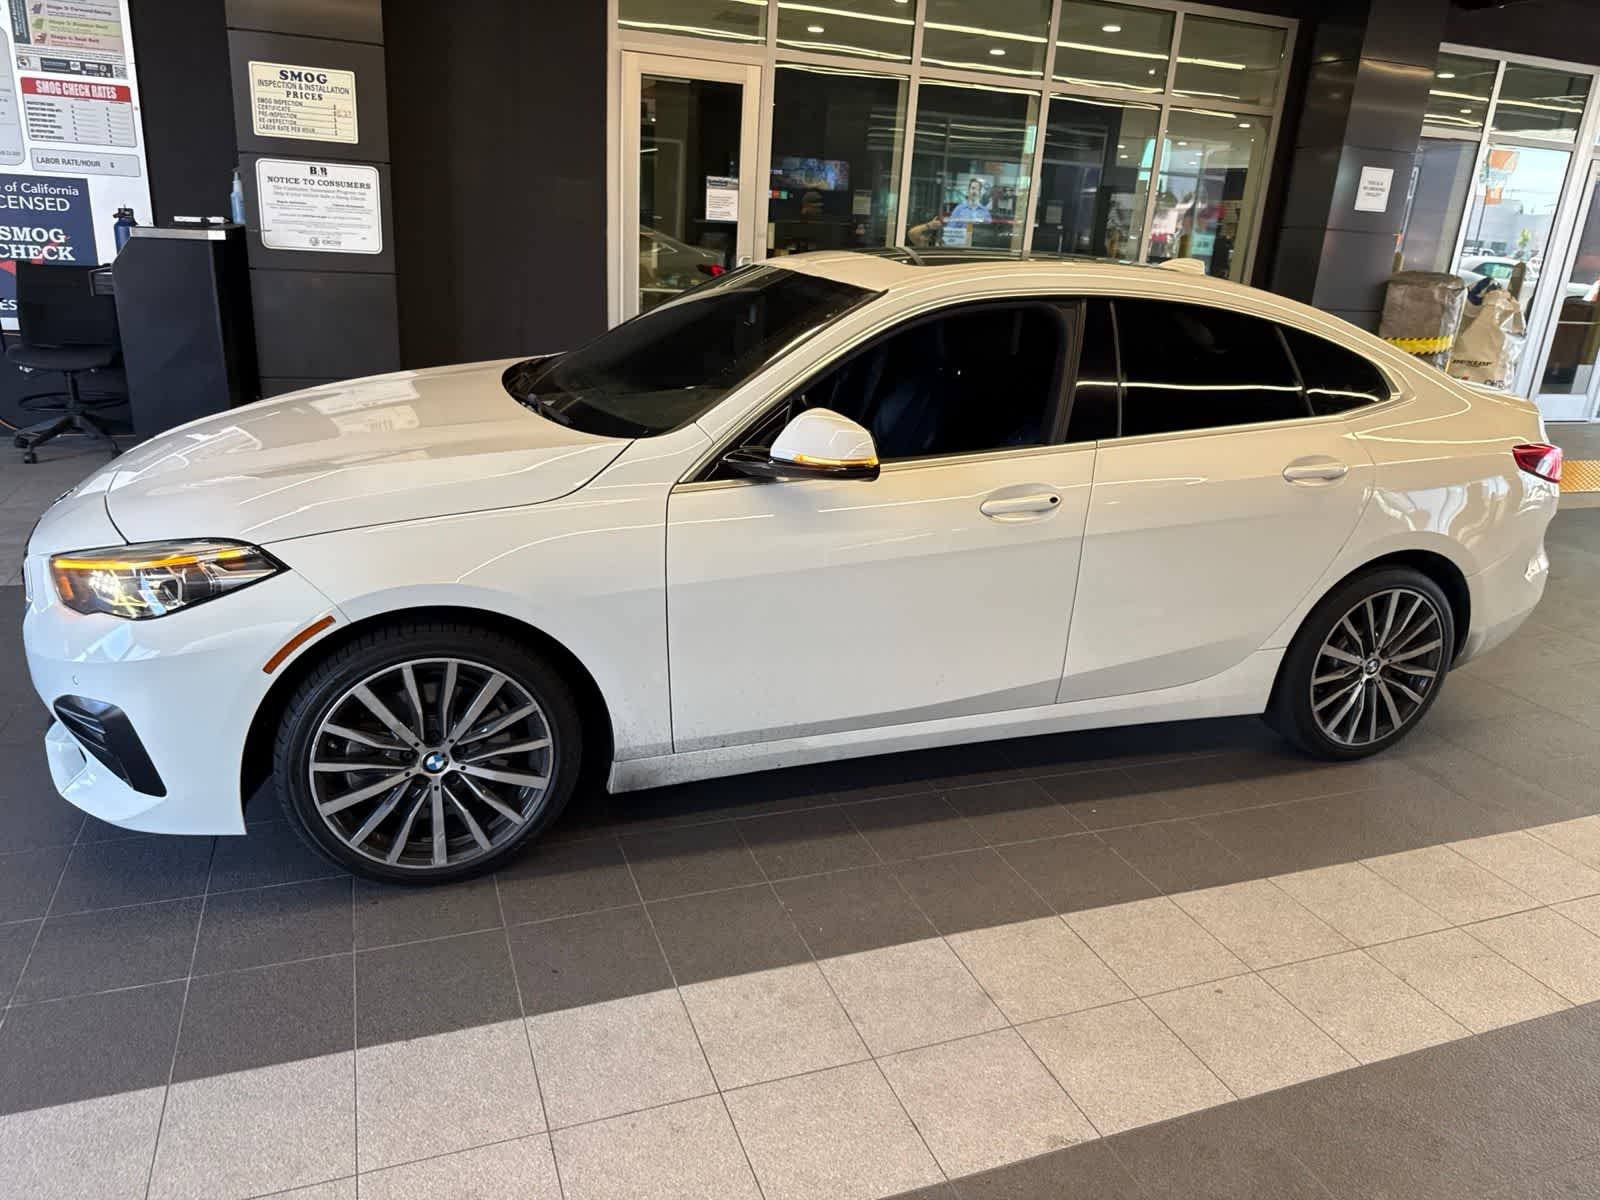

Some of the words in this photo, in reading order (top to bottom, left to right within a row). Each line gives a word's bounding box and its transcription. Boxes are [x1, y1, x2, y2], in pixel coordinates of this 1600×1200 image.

[279, 69, 328, 84] SMOG
[35, 79, 62, 95] SMOG
[62, 82, 91, 97] CHECK
[91, 84, 118, 99] RATES
[257, 80, 297, 90] INSPECTION
[304, 83, 350, 95] INSTALLATION
[286, 91, 323, 101] PRICES
[257, 104, 291, 112] CERTIFICATE
[36, 157, 60, 165] LABOR
[62, 157, 101, 168] RATE/HOUR
[5, 181, 17, 192] of
[21, 182, 80, 196] California
[267, 175, 301, 185] NOTICE
[302, 178, 315, 186] TO
[317, 179, 371, 190] CONSUMERS
[0, 225, 66, 243] SMOG
[0, 243, 77, 261] CHECK
